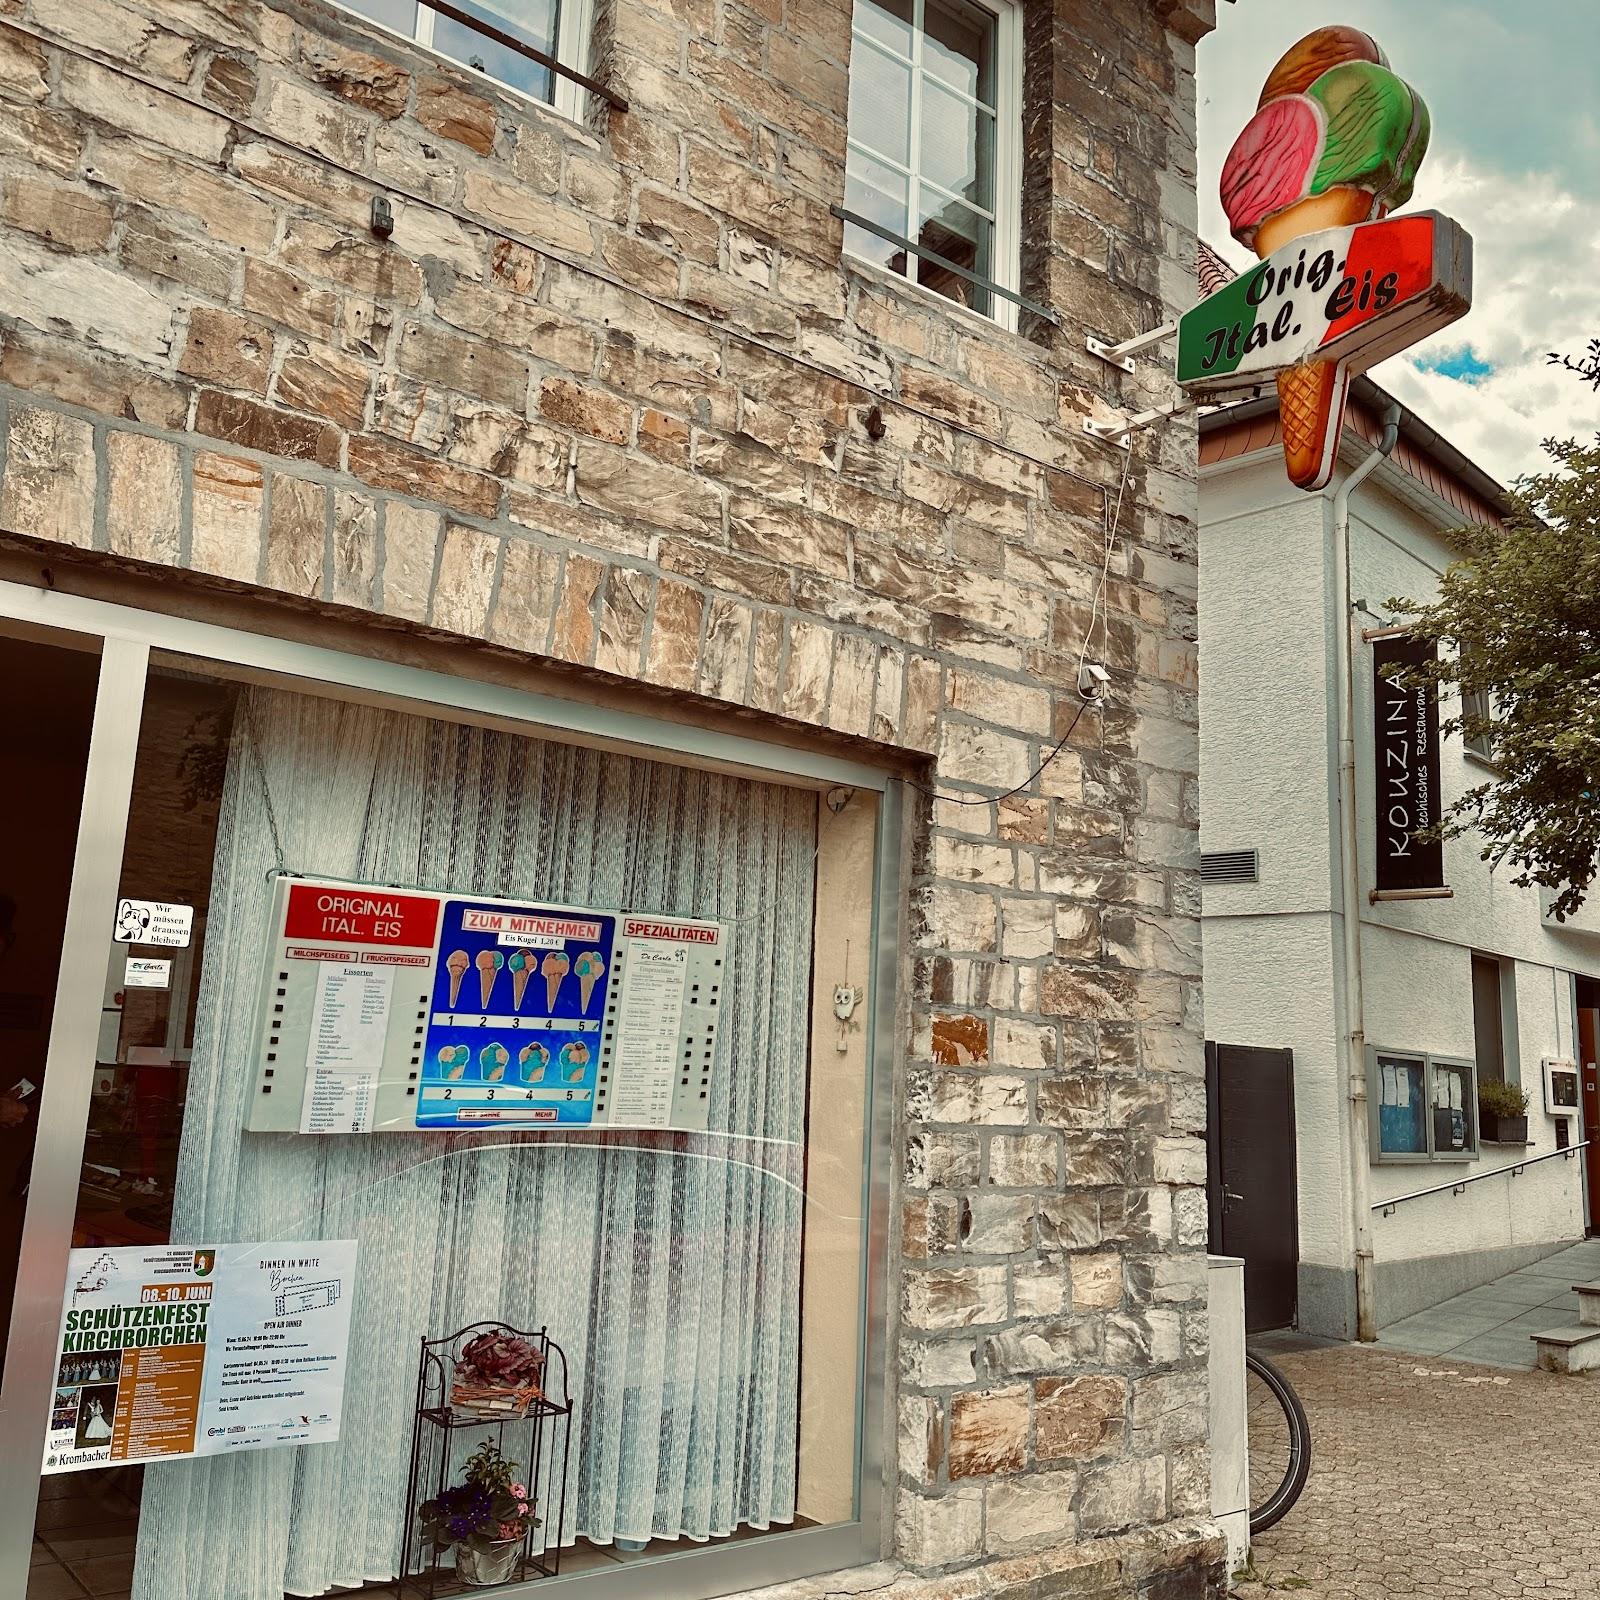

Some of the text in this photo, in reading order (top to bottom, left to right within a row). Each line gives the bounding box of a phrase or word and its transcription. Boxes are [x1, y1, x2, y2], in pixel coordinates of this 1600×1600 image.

[1246, 248, 1347, 307] Orig.
[1201, 267, 1399, 369] Ital. Eis
[1415, 682, 1429, 845] iechisches Restauran
[155, 904, 172, 913] Wir
[317, 895, 405, 919] ORIGINAL
[153, 916, 184, 925] müssen
[322, 917, 402, 938] ITAL. EIS
[469, 914, 597, 938] ZUM MITNEHMEN
[151, 926, 189, 936] draussen
[505, 934, 516, 942] Eis
[517, 935, 537, 944] Kugel
[540, 937, 554, 945] 1,20
[150, 935, 181, 945] bleiben
[293, 950, 351, 960] MILCHSPEISEEIS
[366, 954, 426, 965] FRUCHTSPEISEEIS
[448, 1015, 585, 1032] 1 2 3 4 5
[444, 1089, 573, 1101] 2 3 4 5
[260, 1258, 320, 1270] DINNER IN WHITE
[142, 1285, 212, 1303] 08.-10. JUNI
[66, 1302, 211, 1332] SCHÜTZENFEST
[63, 1323, 208, 1353] KIRCHBORCHEN
[59, 1449, 110, 1466] Krombacher
